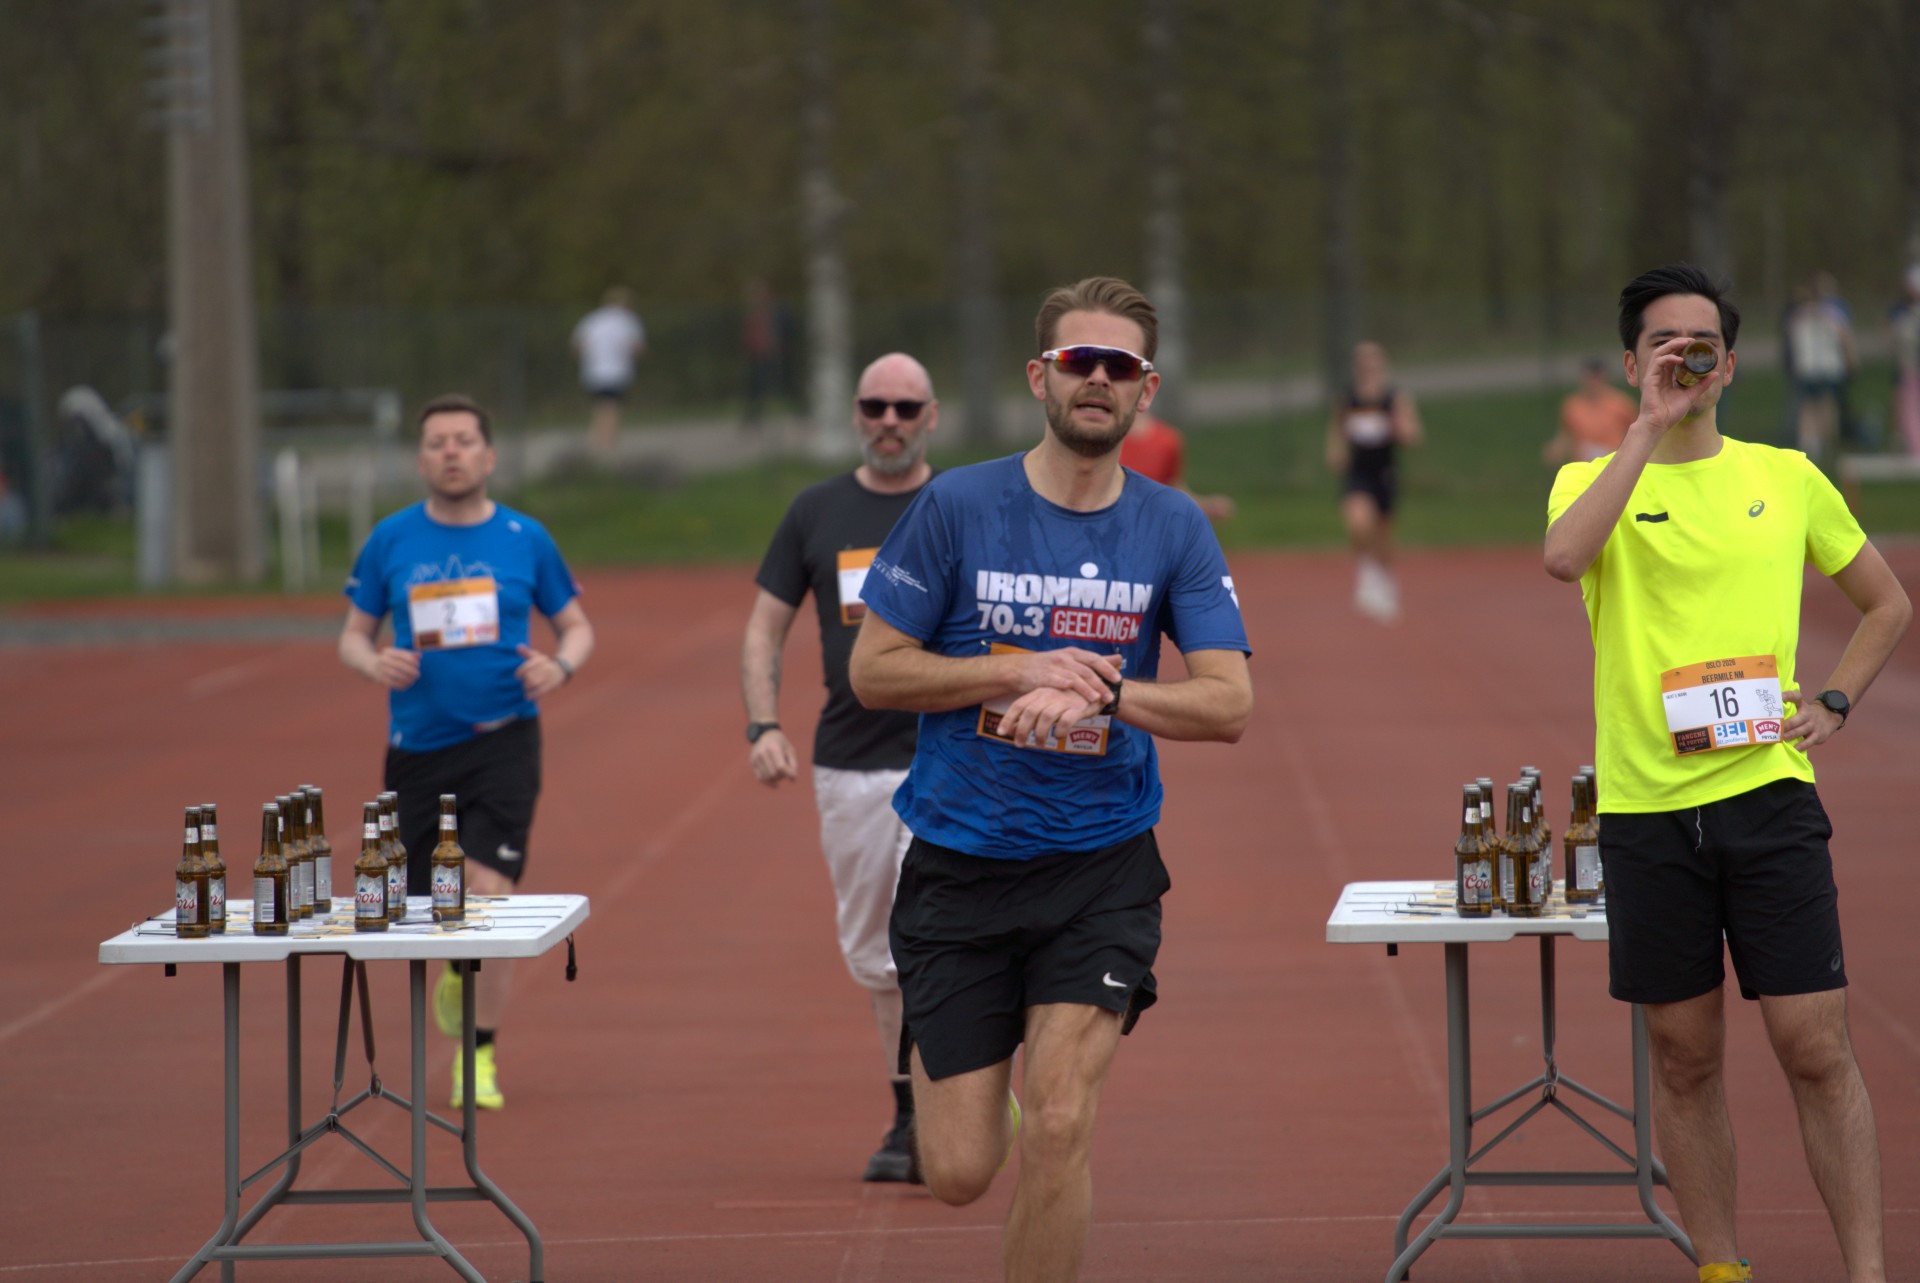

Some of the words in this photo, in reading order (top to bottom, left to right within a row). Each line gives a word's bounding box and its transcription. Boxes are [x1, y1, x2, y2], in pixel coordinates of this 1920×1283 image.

[976, 565, 1153, 613] IRONMAN
[977, 602, 1044, 637] 70.3
[1053, 609, 1131, 641] GEELONG
[1701, 672, 1733, 684] BEERMILE
[1734, 670, 1744, 679] NM
[1705, 660, 1721, 669] OSLO
[1710, 687, 1740, 719] 16
